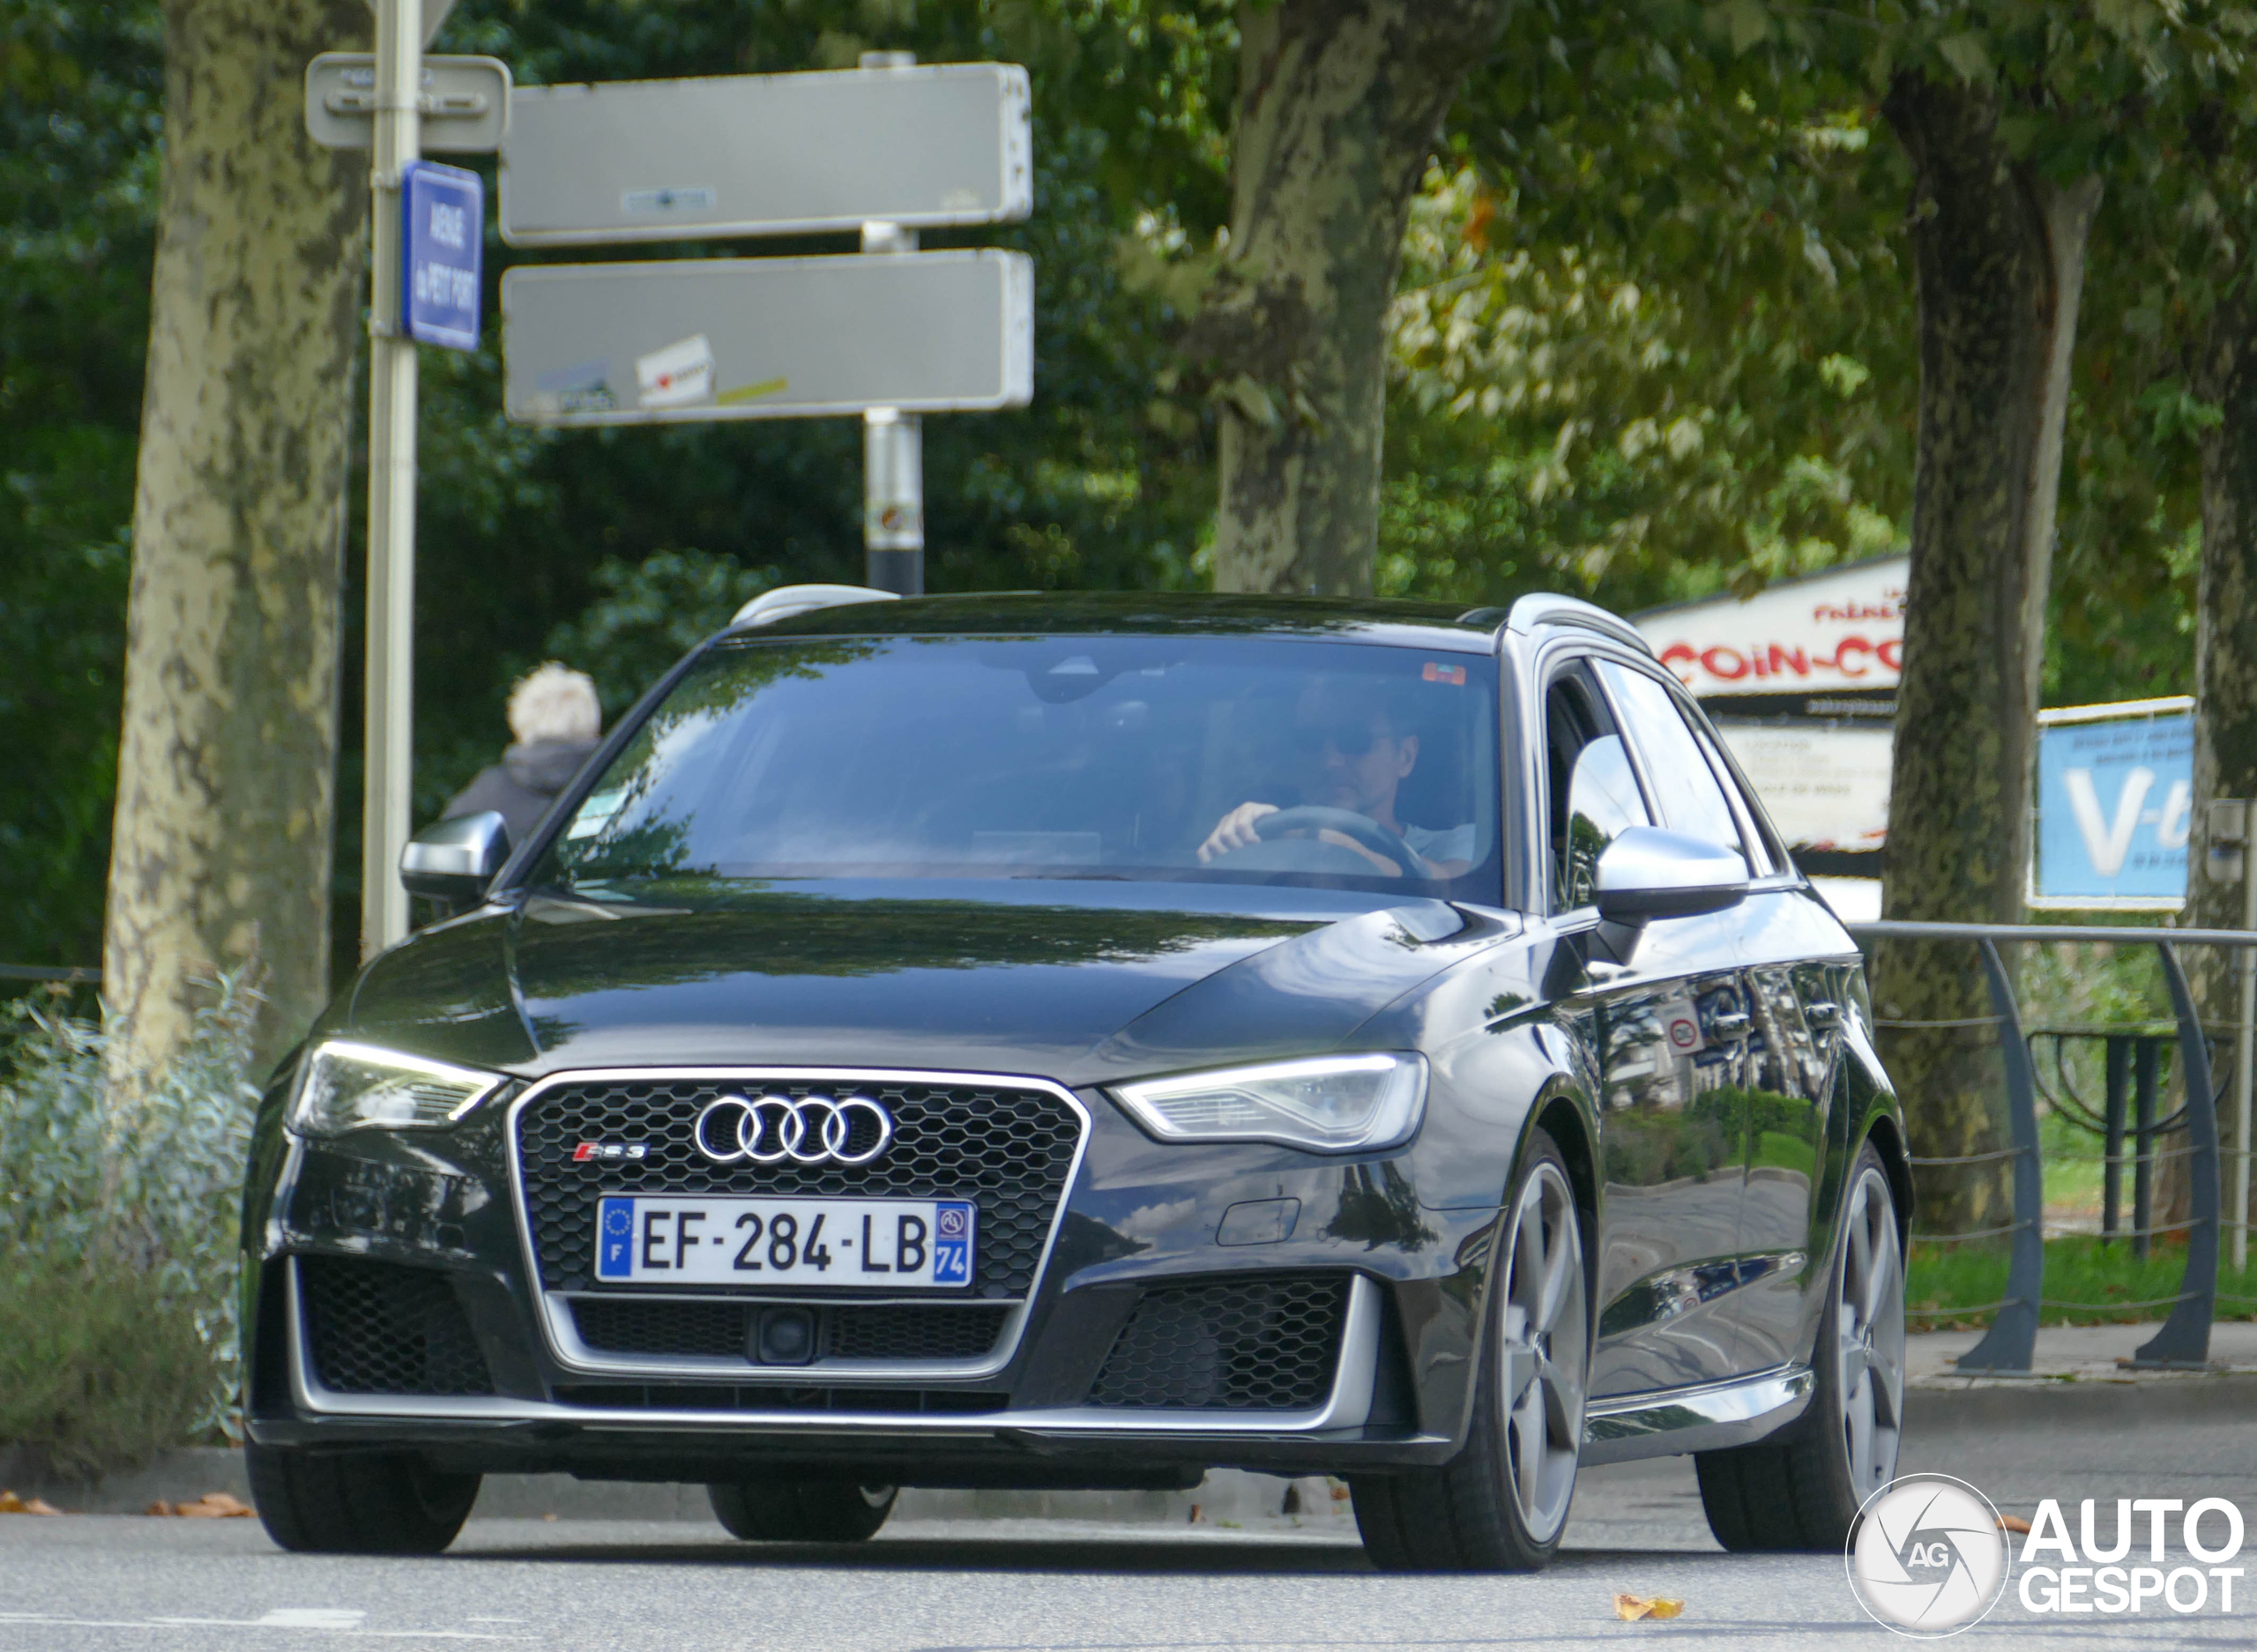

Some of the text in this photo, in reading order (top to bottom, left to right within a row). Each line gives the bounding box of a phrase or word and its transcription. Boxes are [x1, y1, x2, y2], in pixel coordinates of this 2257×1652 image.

[610, 1245, 622, 1262] F
[643, 1212, 927, 1274] EF-284-LB
[935, 1246, 965, 1275] 74
